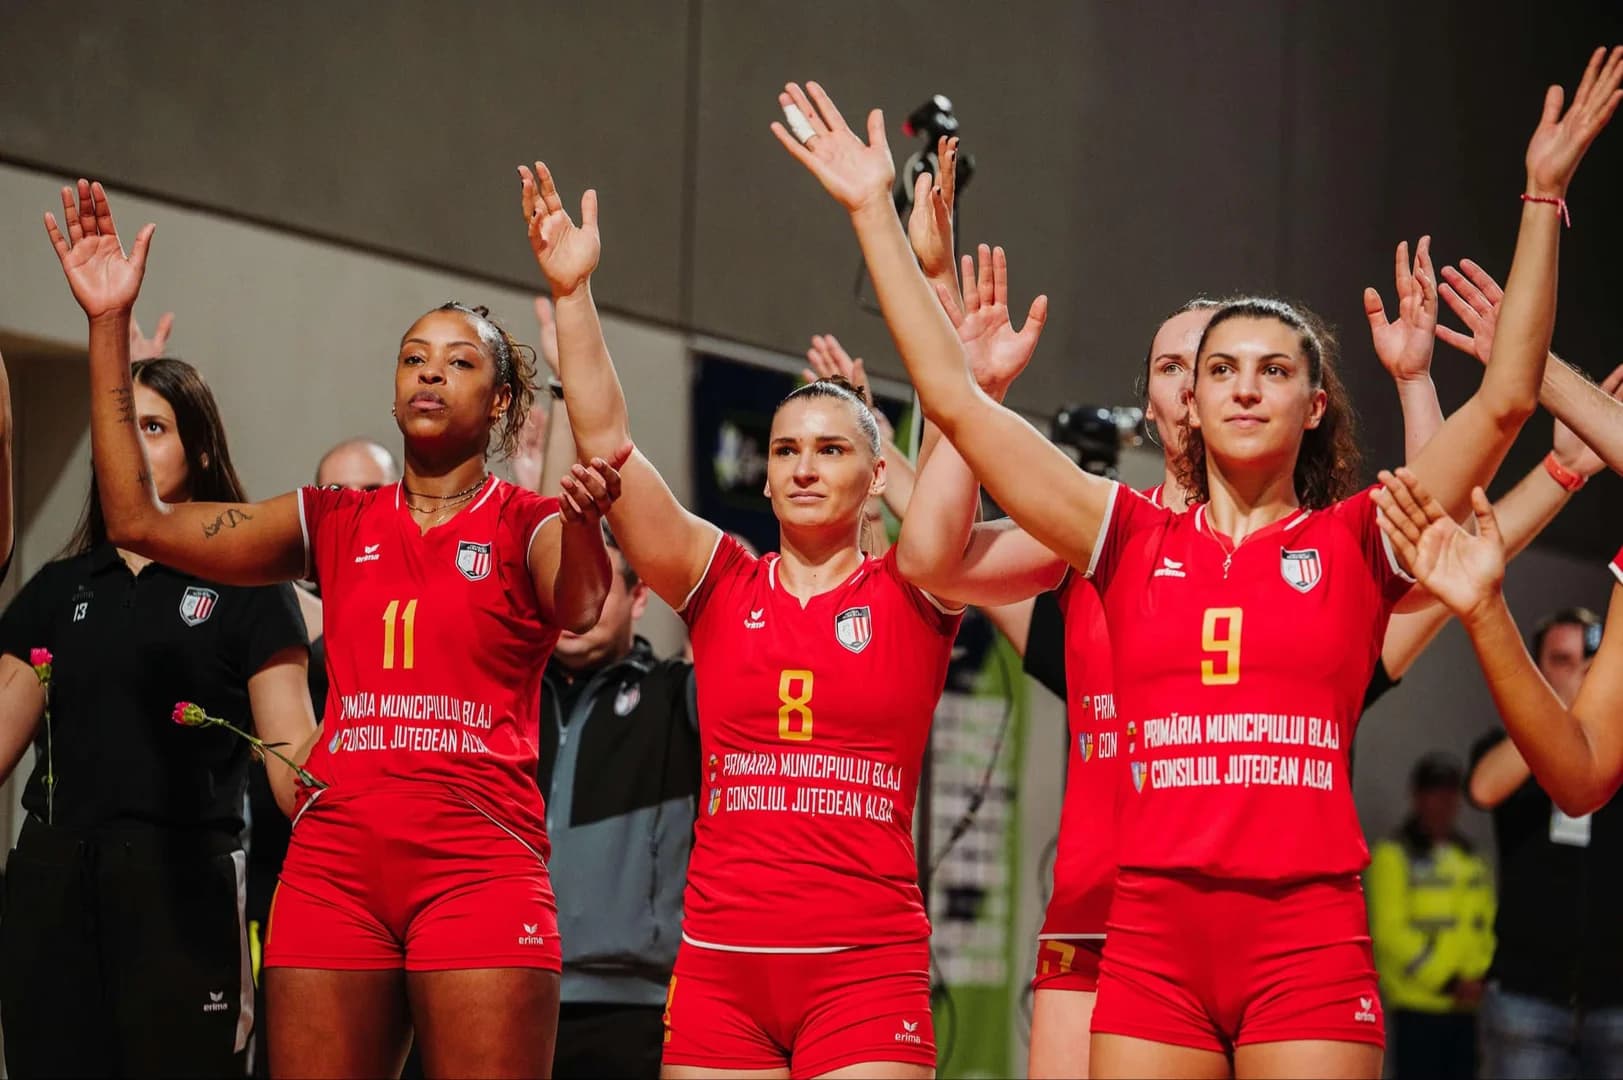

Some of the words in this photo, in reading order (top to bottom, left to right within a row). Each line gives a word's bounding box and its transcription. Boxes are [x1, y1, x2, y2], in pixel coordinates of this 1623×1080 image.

[73, 602, 88, 622] 13
[382, 598, 418, 669] 11
[1201, 607, 1243, 686] 9
[379, 693, 461, 723] MUNICIPIULUI
[462, 700, 492, 729] BLAJ
[778, 669, 814, 741] 8
[1143, 712, 1202, 750] PRIMĂRIA
[1206, 712, 1305, 746] MUNICIPIULUI
[1308, 716, 1340, 751] BLAJ
[779, 752, 870, 785] MUNICIPIULUI
[872, 762, 902, 792] BLAJ
[1151, 756, 1221, 789] CONSILIUL
[1302, 757, 1334, 791] ALBA
[726, 785, 788, 812] CONSILIUL
[865, 794, 894, 823] ALBA
[518, 935, 544, 945] erima
[895, 1032, 921, 1044] erima
